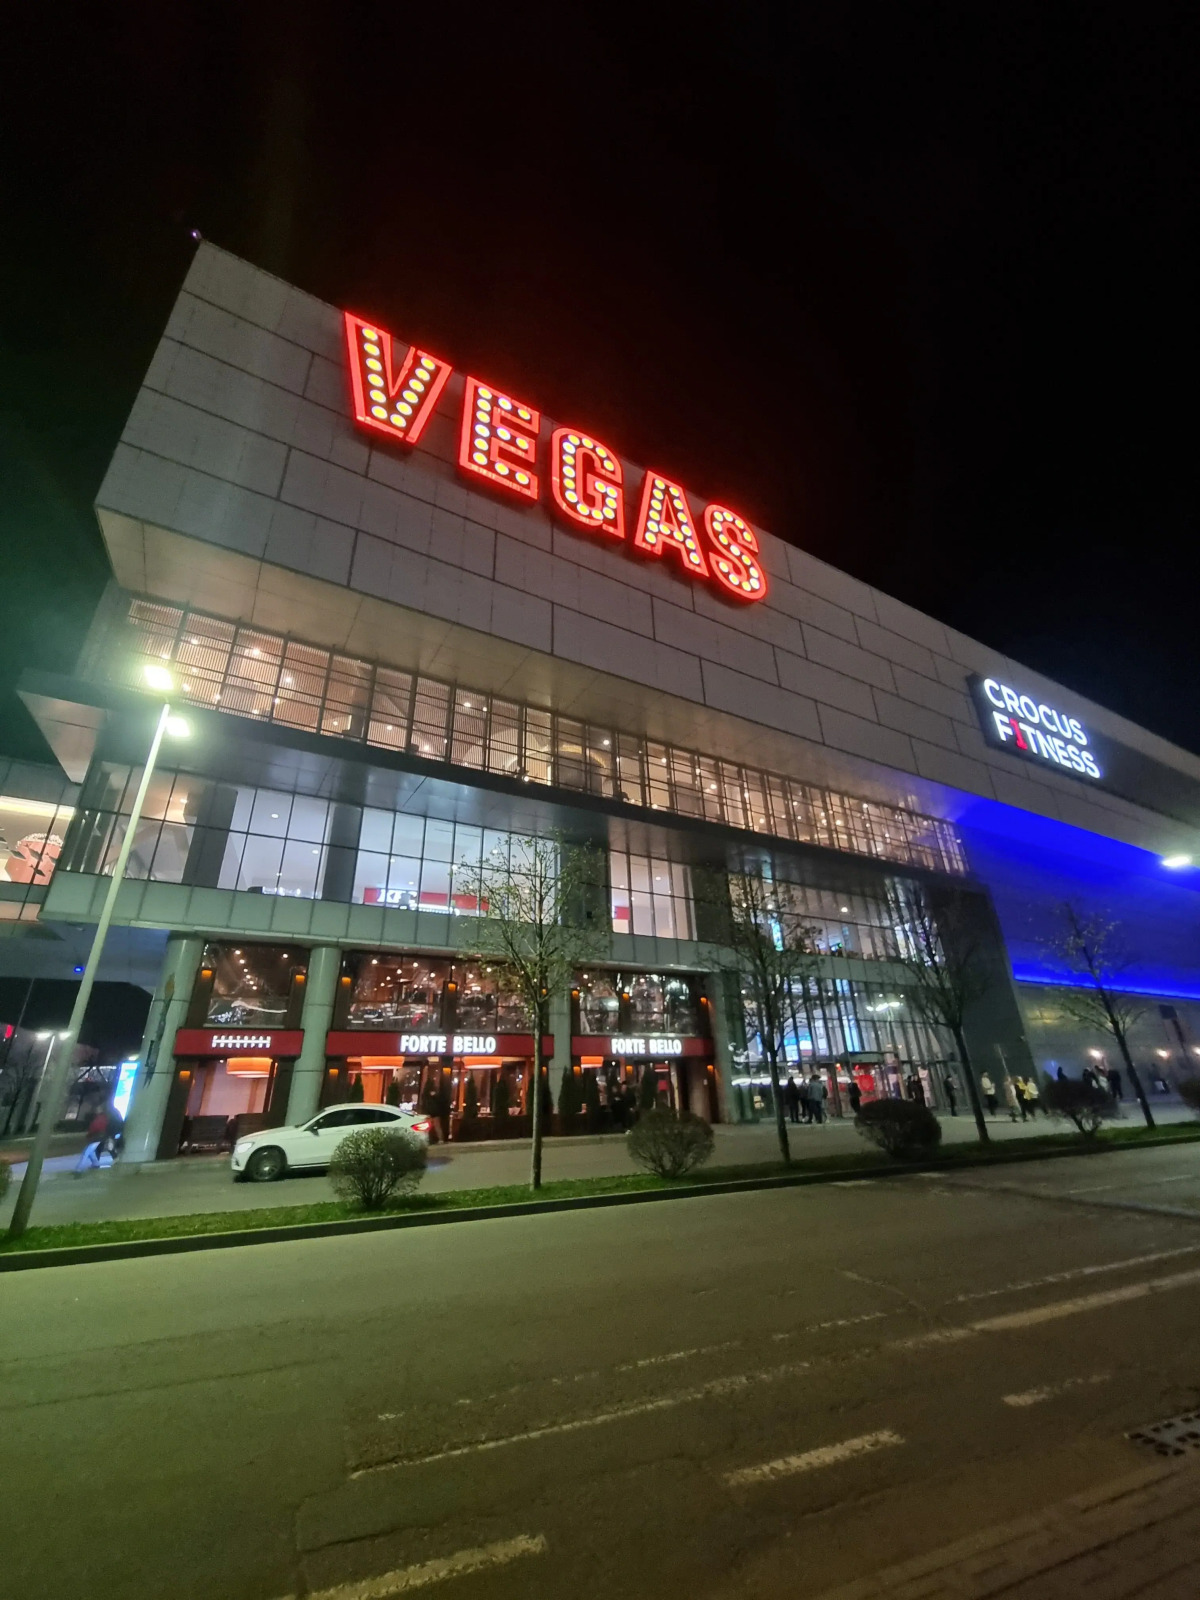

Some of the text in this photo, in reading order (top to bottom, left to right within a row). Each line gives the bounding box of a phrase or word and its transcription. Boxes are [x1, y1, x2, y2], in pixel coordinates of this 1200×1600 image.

[344, 311, 768, 600] VEGAS
[983, 678, 1088, 746] CROCUS
[992, 711, 1100, 779] FITNESS
[400, 1034, 497, 1054] FORTE BELLO
[611, 1038, 682, 1055] FORTE BELLO
